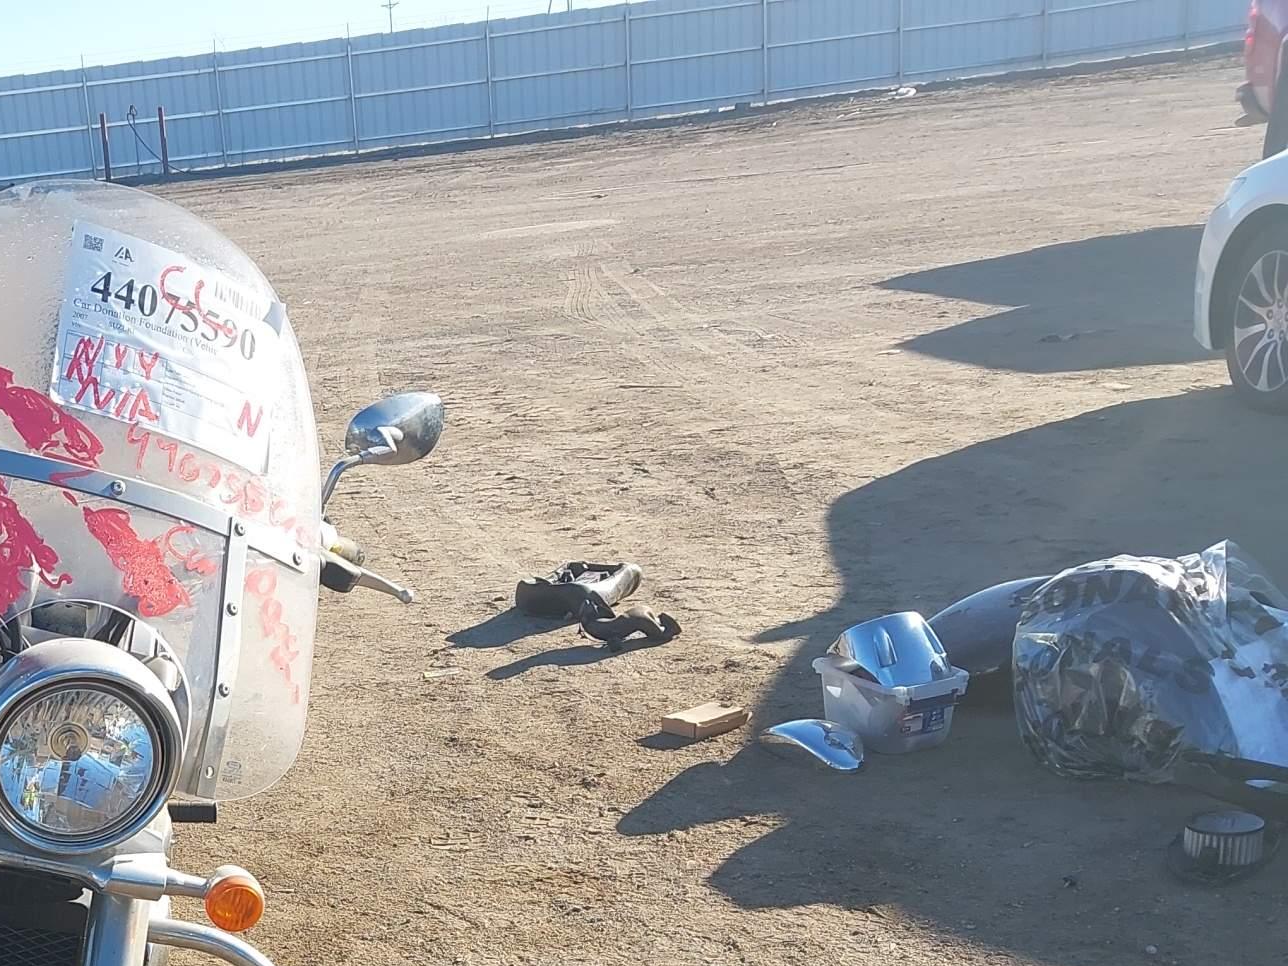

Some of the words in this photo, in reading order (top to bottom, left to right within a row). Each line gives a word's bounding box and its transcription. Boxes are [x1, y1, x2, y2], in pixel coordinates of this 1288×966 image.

[73, 298, 92, 310] Car
[93, 303, 137, 325] Donation
[138, 317, 189, 344] Foundation
[91, 271, 256, 361] 44075590
